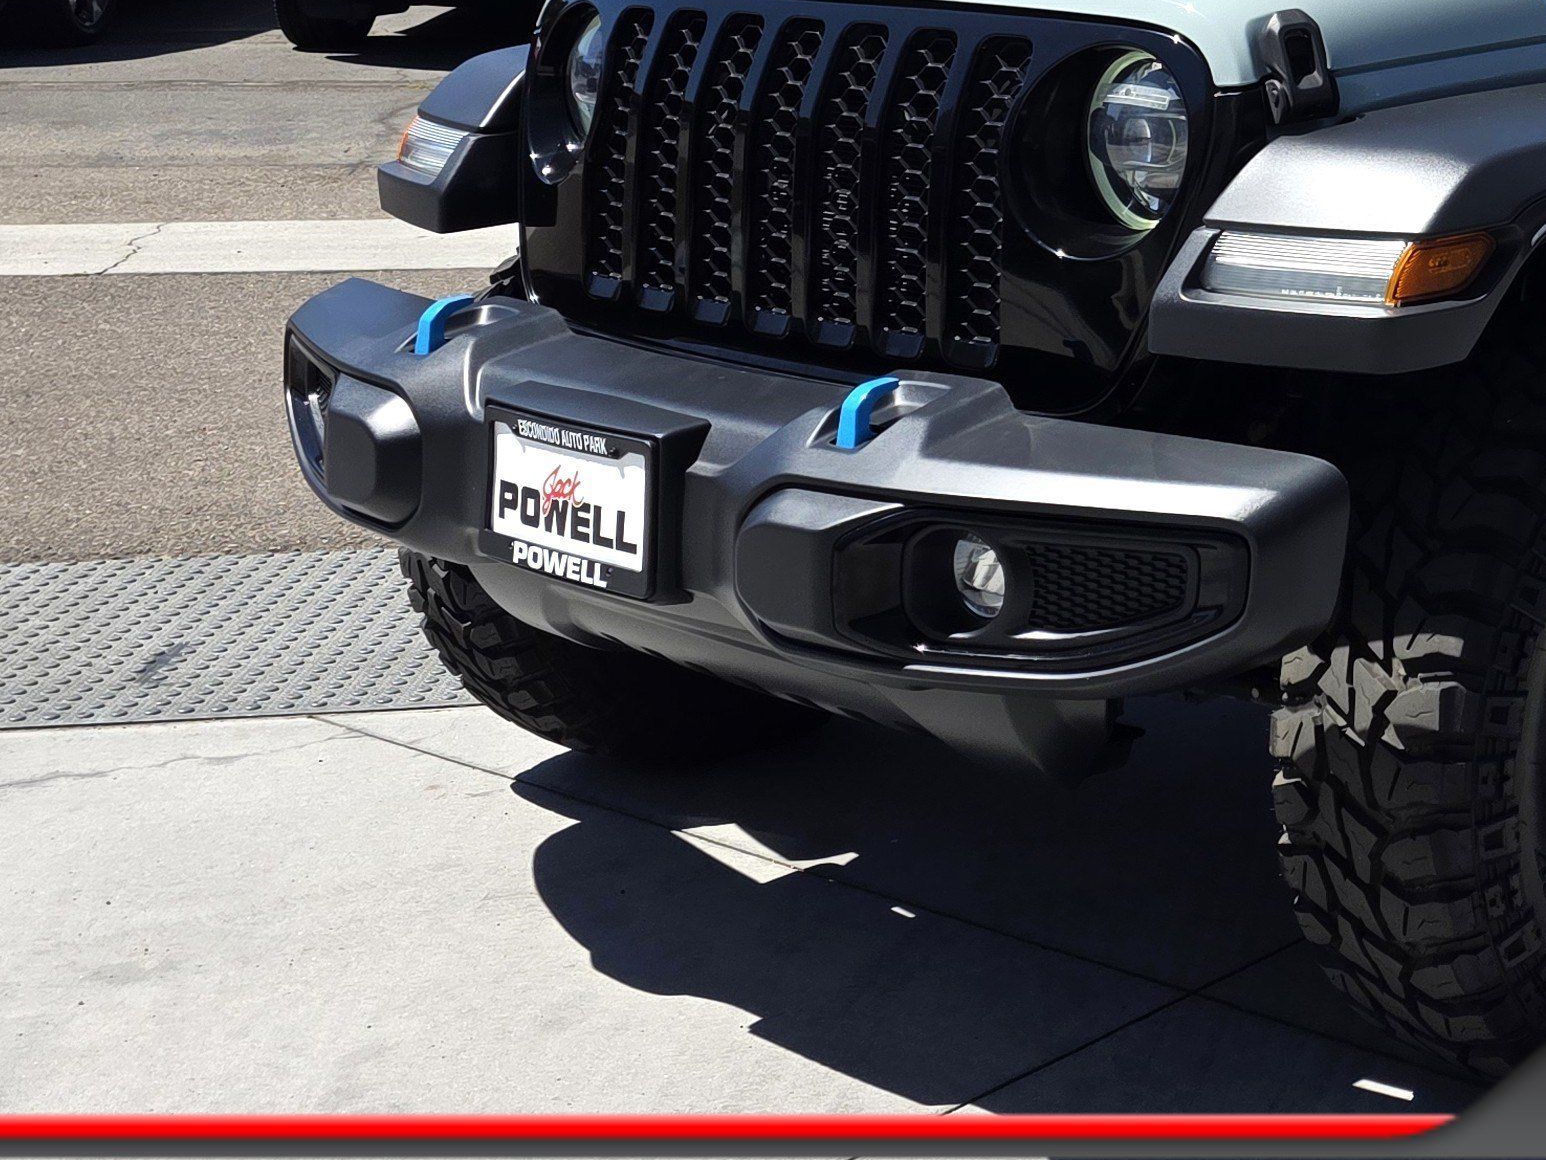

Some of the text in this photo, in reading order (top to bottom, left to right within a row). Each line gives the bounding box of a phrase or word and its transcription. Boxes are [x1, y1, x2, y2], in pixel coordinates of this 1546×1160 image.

[516, 418, 608, 456] ESCONDIDO AUTO PARK
[542, 464, 584, 516] Jack
[498, 479, 638, 555] POWELL
[512, 539, 608, 588] POWELL
